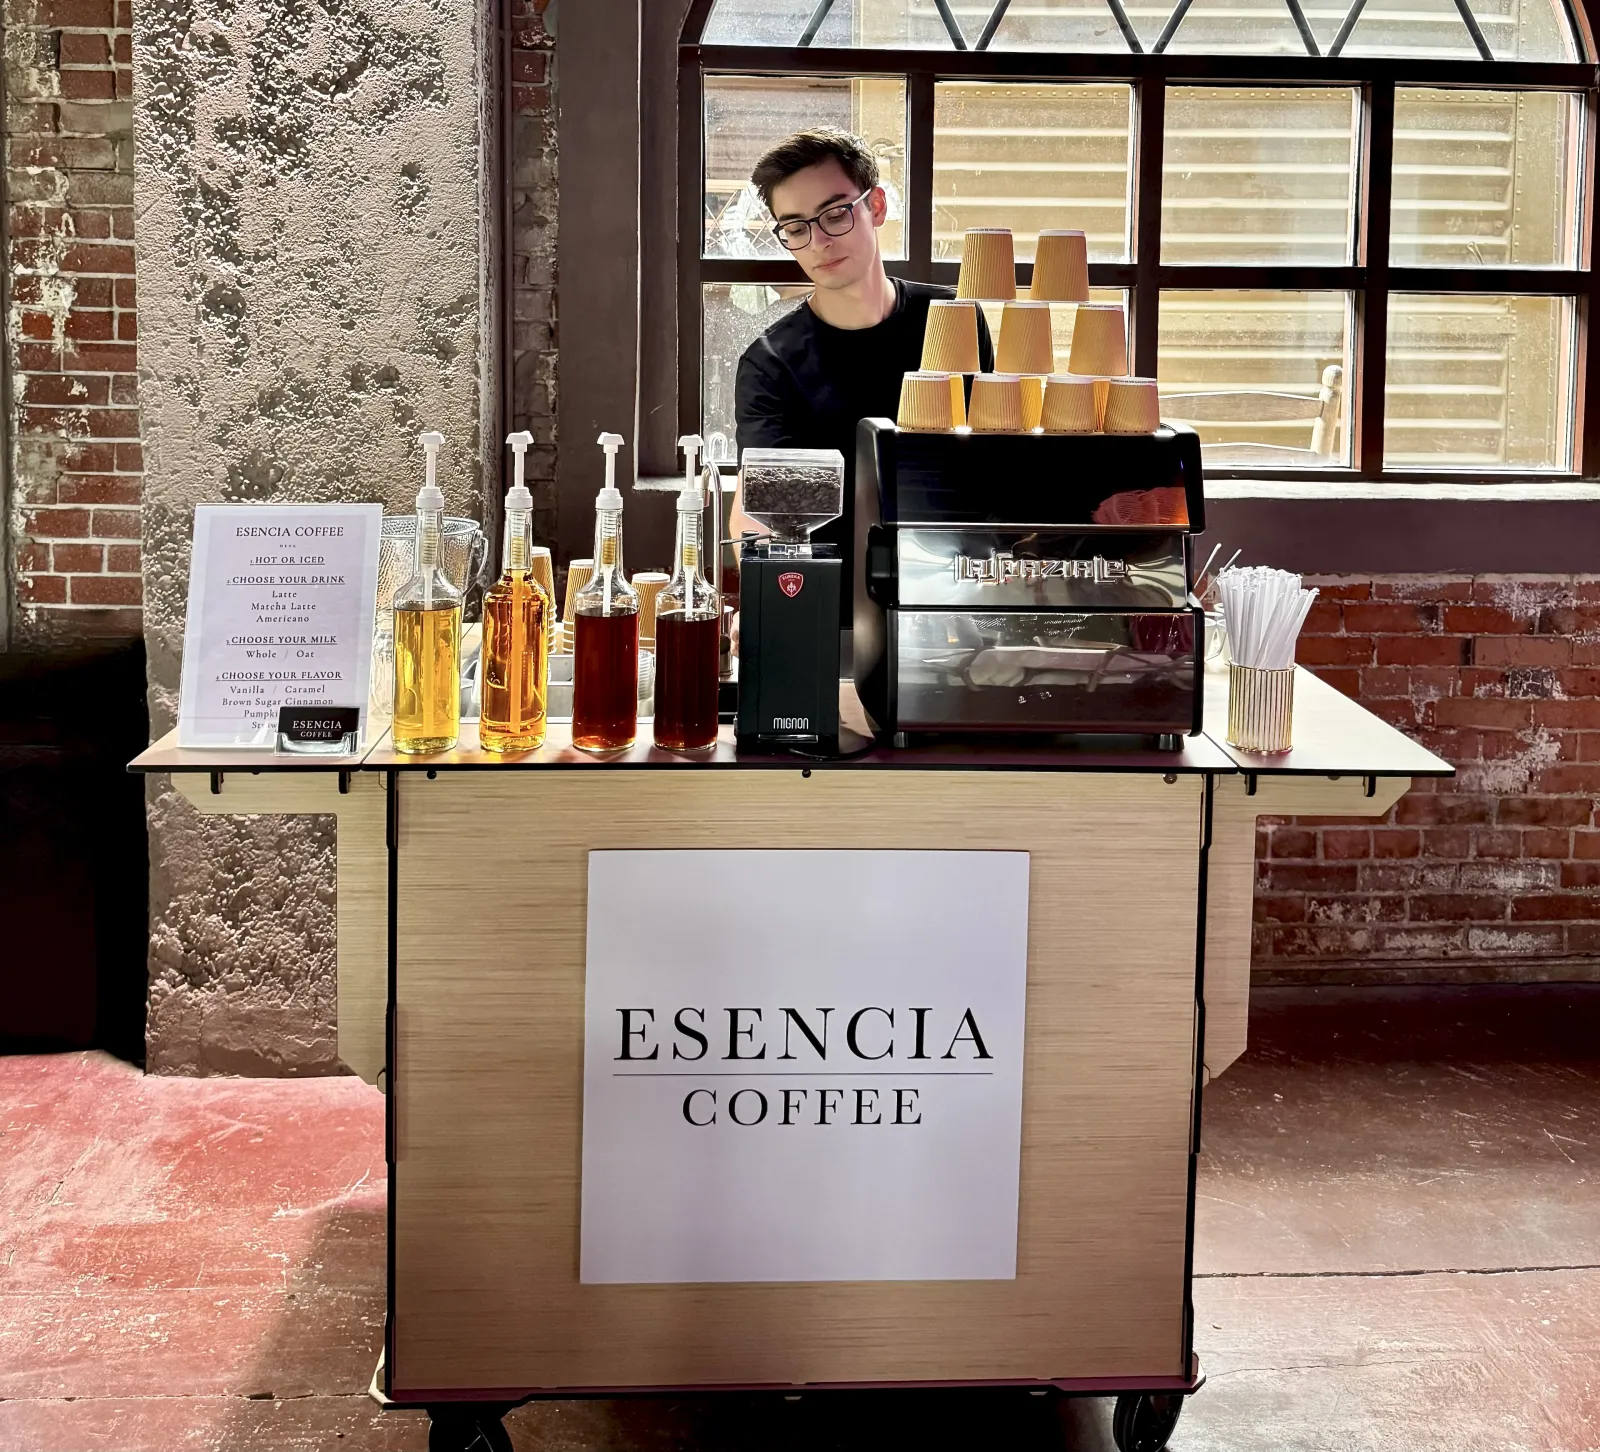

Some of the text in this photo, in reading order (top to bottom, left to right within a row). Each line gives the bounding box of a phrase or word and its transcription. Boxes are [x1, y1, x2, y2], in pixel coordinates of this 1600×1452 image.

[236, 526, 344, 537] ESENCIA COFFEE
[255, 556, 278, 564] HOT
[281, 556, 296, 564] OR
[300, 556, 325, 564] ICED
[232, 576, 275, 584] CHOOSE
[279, 576, 308, 584] YOUR
[311, 575, 345, 584] DRINK
[272, 590, 297, 598] Latte
[251, 601, 317, 611] Matcha Latte
[256, 614, 310, 623] Americano
[231, 636, 275, 644] CHOOSE
[278, 636, 307, 644] YOUR
[311, 635, 337, 643] MILK
[246, 649, 277, 659] Whole
[296, 649, 315, 658] Oat
[221, 671, 265, 680] CHOOSE
[269, 671, 297, 679] YOUR
[301, 671, 342, 679] FLAVOR
[230, 685, 265, 694] Vanilla
[285, 685, 325, 694] Caramel
[222, 697, 334, 708] Brown Sugar Cinnamon
[244, 709, 279, 720] Pumpki
[292, 720, 342, 729] ESENCIA
[613, 1007, 994, 1061] ESENCIA
[682, 1088, 922, 1127] COFFEE
